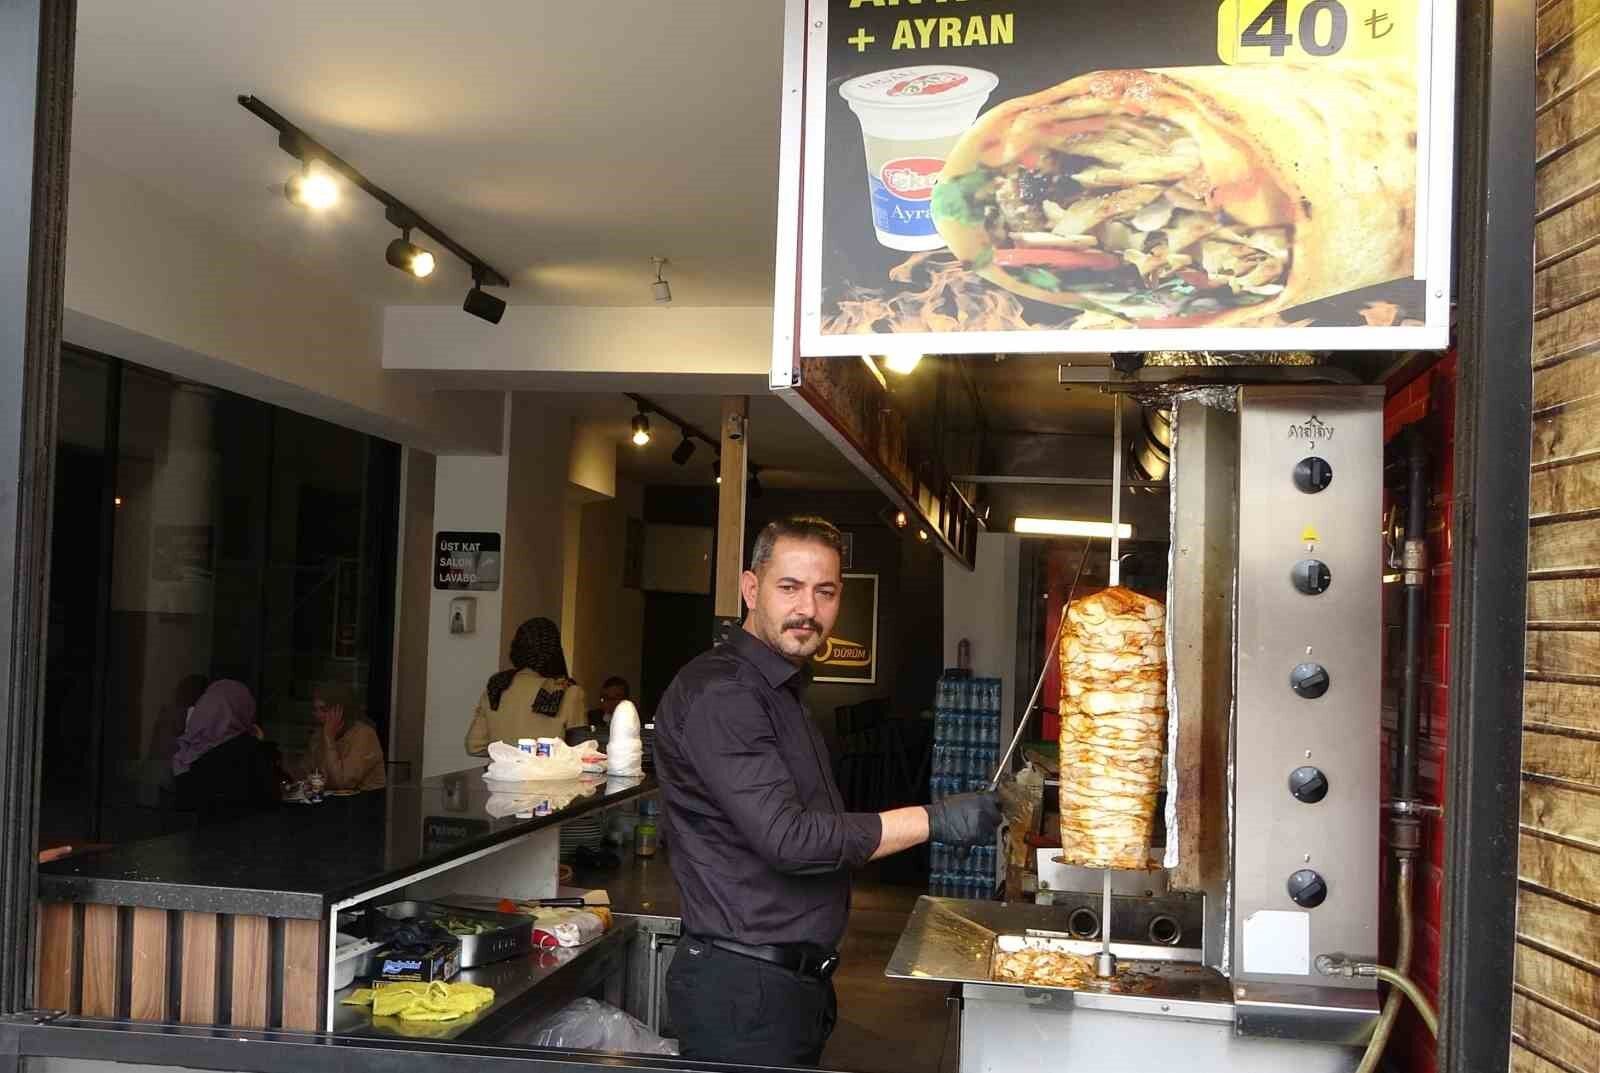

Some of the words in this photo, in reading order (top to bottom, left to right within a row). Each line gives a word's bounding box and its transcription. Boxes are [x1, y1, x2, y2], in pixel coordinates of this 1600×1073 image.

[848, 28, 875, 52] +
[891, 13, 1015, 50] AYRAN
[1240, 0, 1348, 57] 40
[890, 204, 932, 224] Ayra
[440, 539, 460, 551] ÜST
[462, 543, 481, 552] KAT
